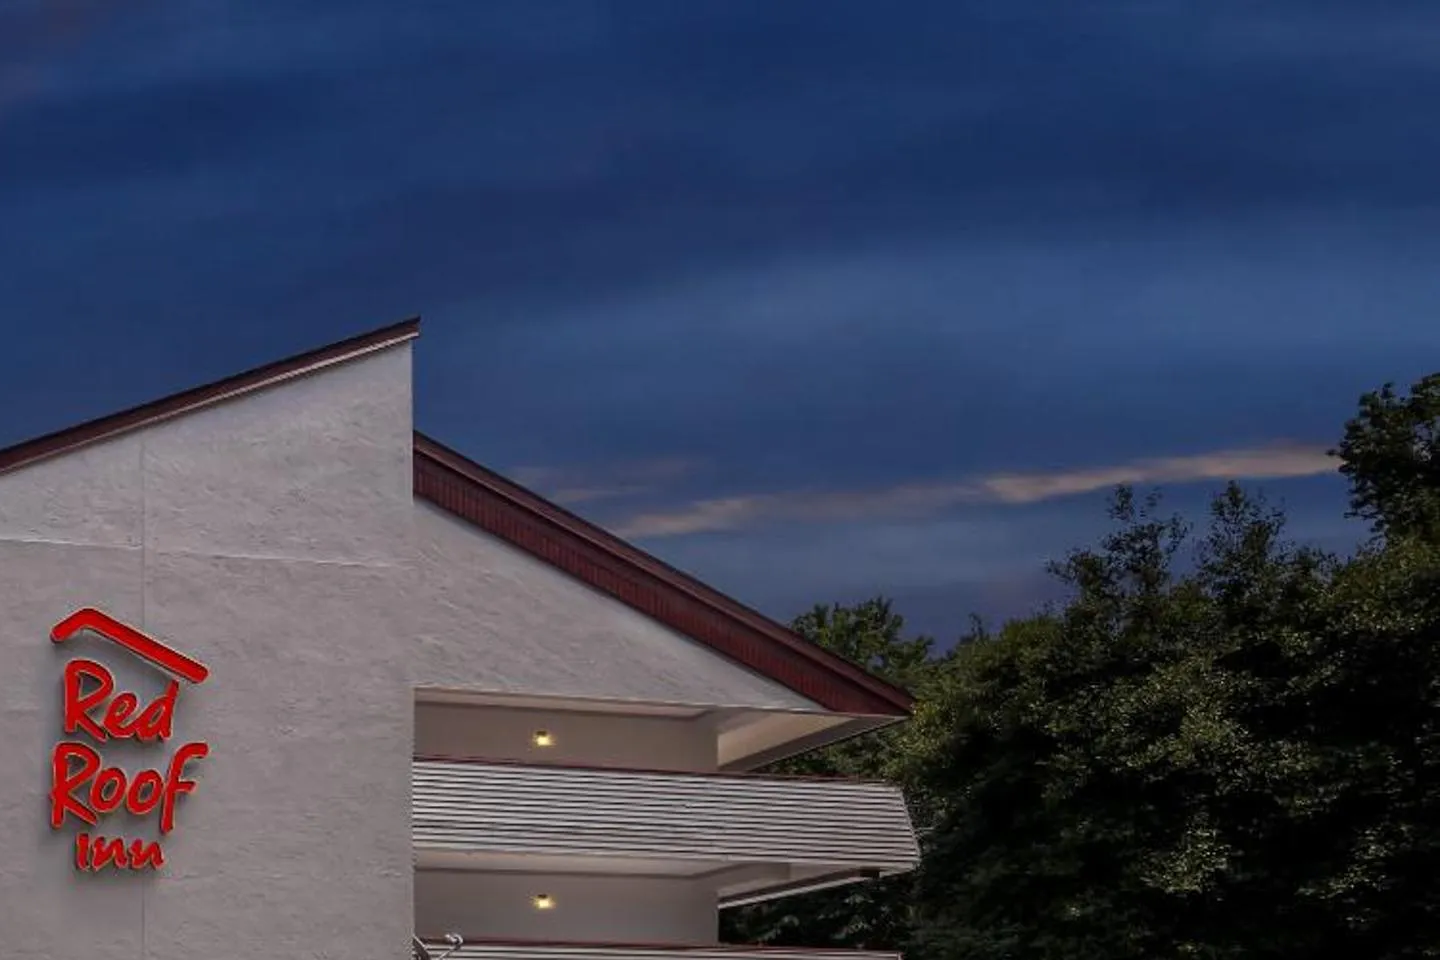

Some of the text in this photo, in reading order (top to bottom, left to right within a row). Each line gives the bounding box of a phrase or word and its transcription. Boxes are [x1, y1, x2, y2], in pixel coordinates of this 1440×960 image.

[63, 658, 180, 742] Red
[49, 742, 210, 834] Roof
[75, 832, 166, 871] Inn
